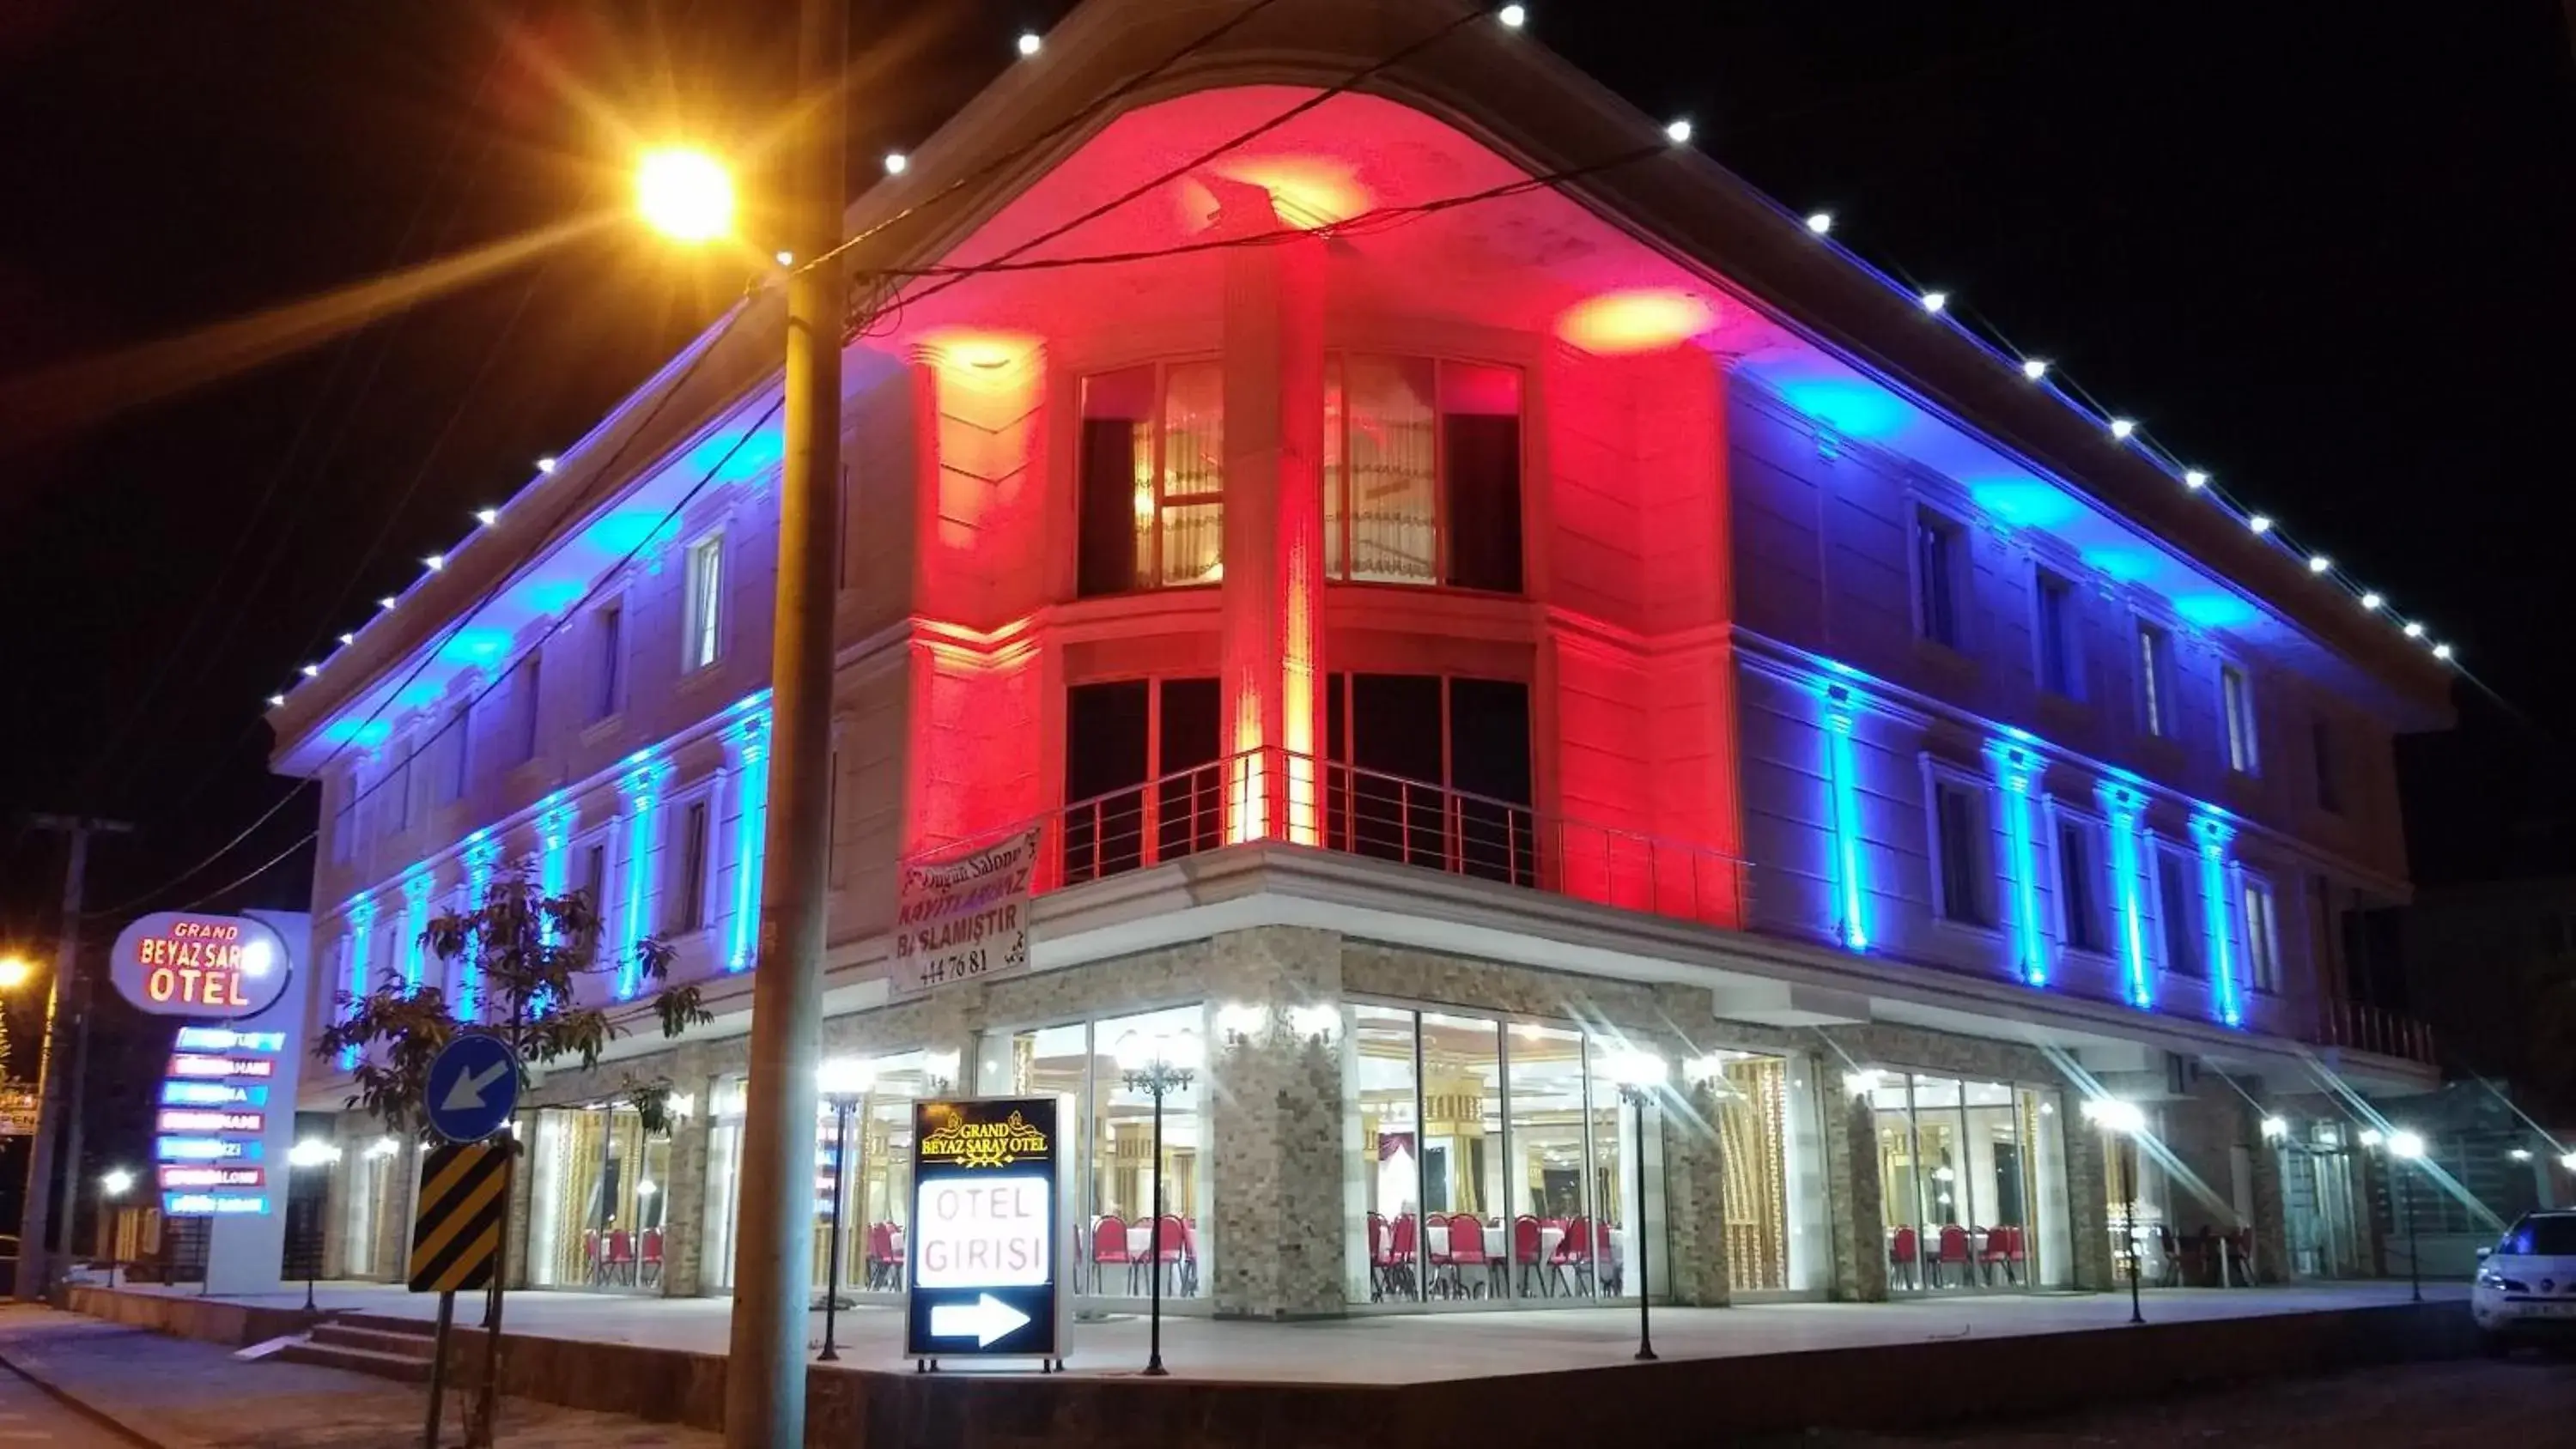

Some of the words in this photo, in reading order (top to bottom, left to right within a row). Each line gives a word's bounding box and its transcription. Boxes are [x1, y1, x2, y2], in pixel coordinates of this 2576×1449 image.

[174, 922, 238, 941] GRAND
[140, 938, 202, 967] BEYAZ
[969, 949, 987, 973] 81
[149, 967, 249, 1006] OTEL
[961, 1123, 1009, 1138] GRAND
[921, 1139, 964, 1155] BEYAZ
[966, 1137, 1008, 1153] SARAY
[1009, 1137, 1048, 1152] OTEL
[936, 1187, 1034, 1220] OTEL
[926, 1237, 1039, 1272] GIRISI
